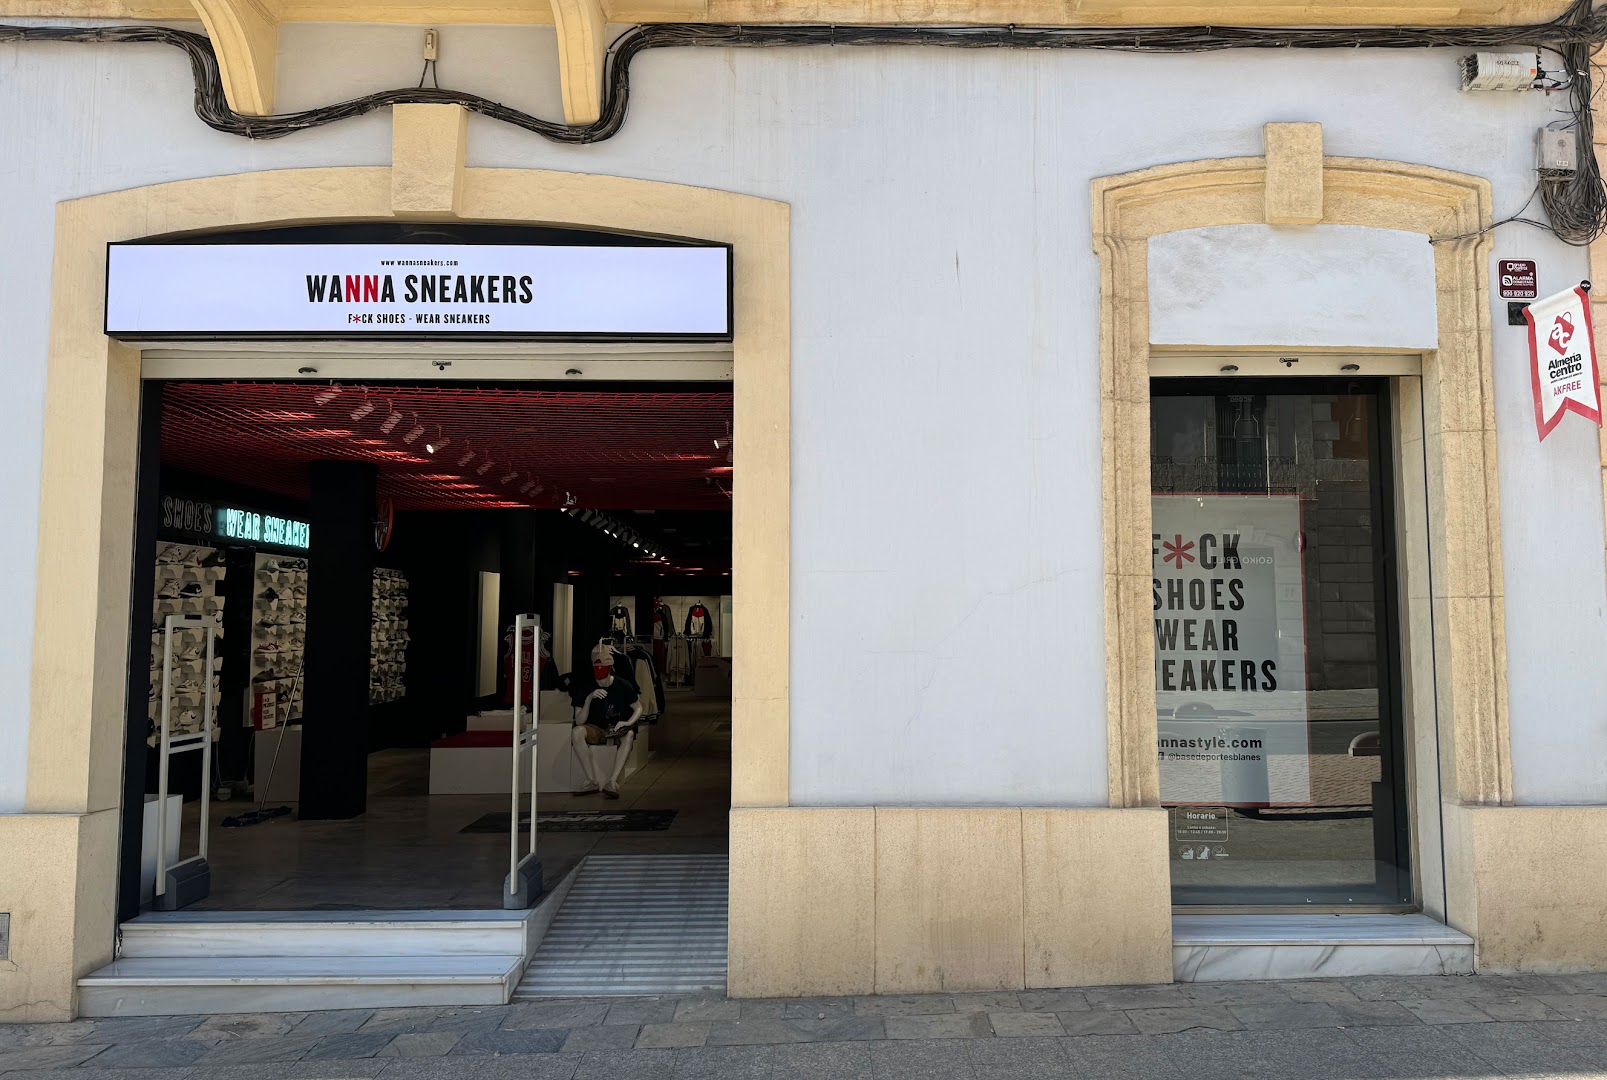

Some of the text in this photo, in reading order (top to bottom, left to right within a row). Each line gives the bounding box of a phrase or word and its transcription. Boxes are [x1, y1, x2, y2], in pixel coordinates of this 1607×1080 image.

[306, 274, 533, 304] WANNA SNEAKERS
[376, 313, 406, 324] SHOES
[415, 313, 441, 324] WEAR
[443, 313, 491, 324] SNEAKERS
[1548, 353, 1582, 371] Almería
[1549, 362, 1582, 379] centro
[163, 496, 213, 534] SHOES
[226, 508, 260, 541] WEAR
[1152, 578, 1245, 611] SHOES
[1154, 618, 1239, 651] WEAR
[1155, 659, 1277, 693] EAKERS
[1157, 736, 1262, 751] nnastyle.com
[1167, 752, 1261, 762] @basedeportesblanes
[1186, 811, 1216, 820] Horario
